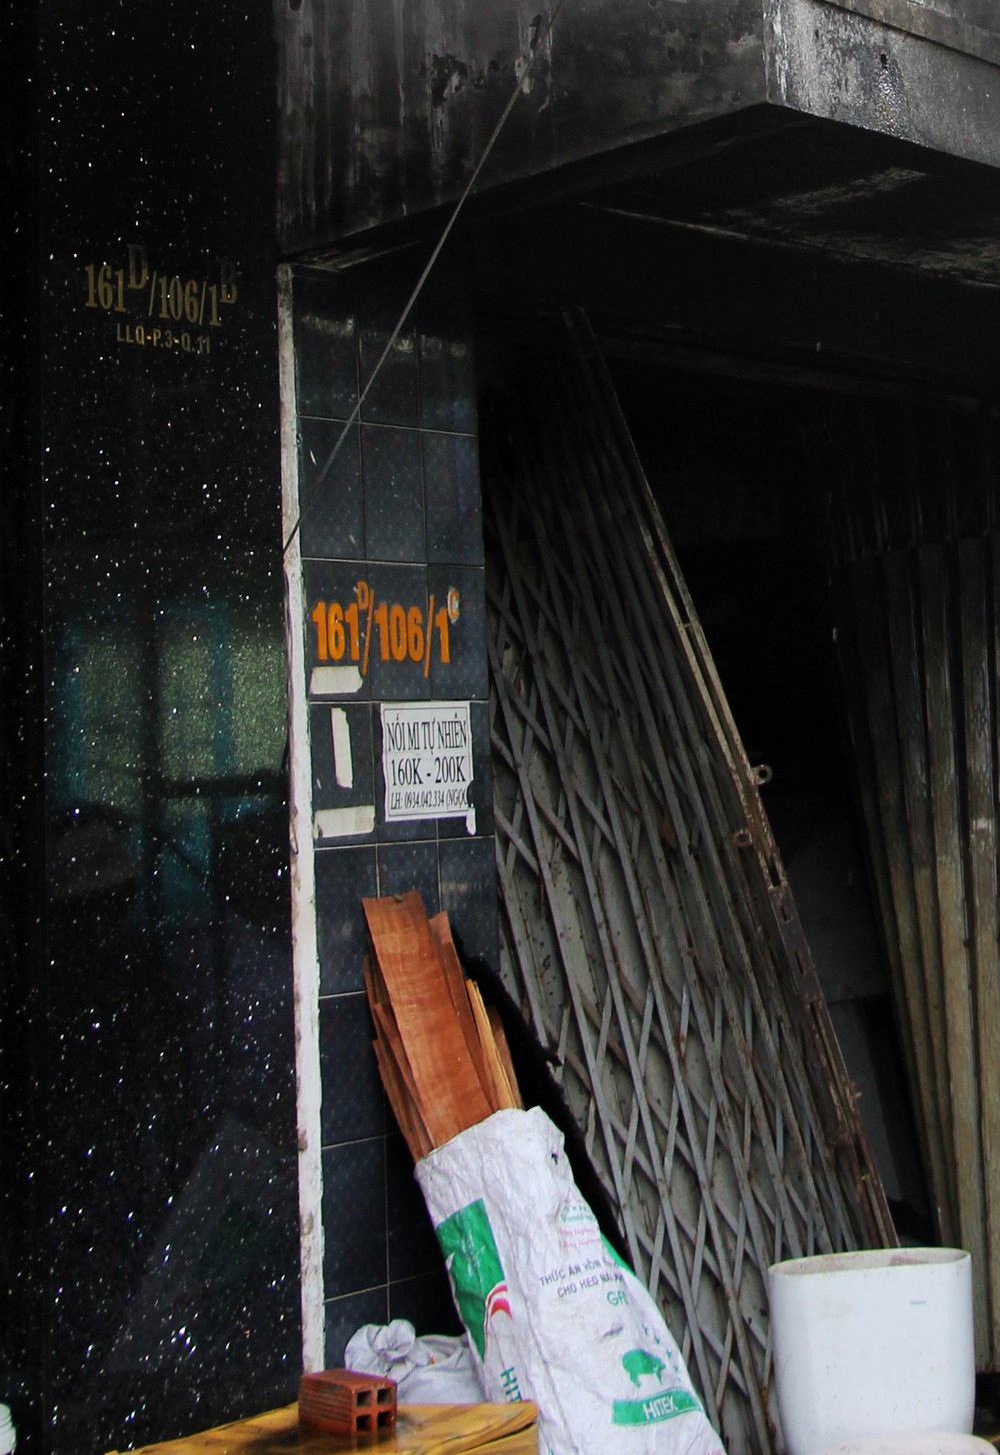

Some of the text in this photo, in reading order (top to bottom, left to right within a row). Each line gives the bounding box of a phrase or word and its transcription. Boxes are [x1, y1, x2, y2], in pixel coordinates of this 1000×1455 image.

[387, 712, 467, 755] NỐI MI TỰ NHIÊN
[391, 758, 423, 786] 160K
[434, 756, 466, 784] 200K
[391, 792, 402, 810] LH:
[557, 1283, 578, 1298] CHO
[580, 1276, 599, 1290] HEO
